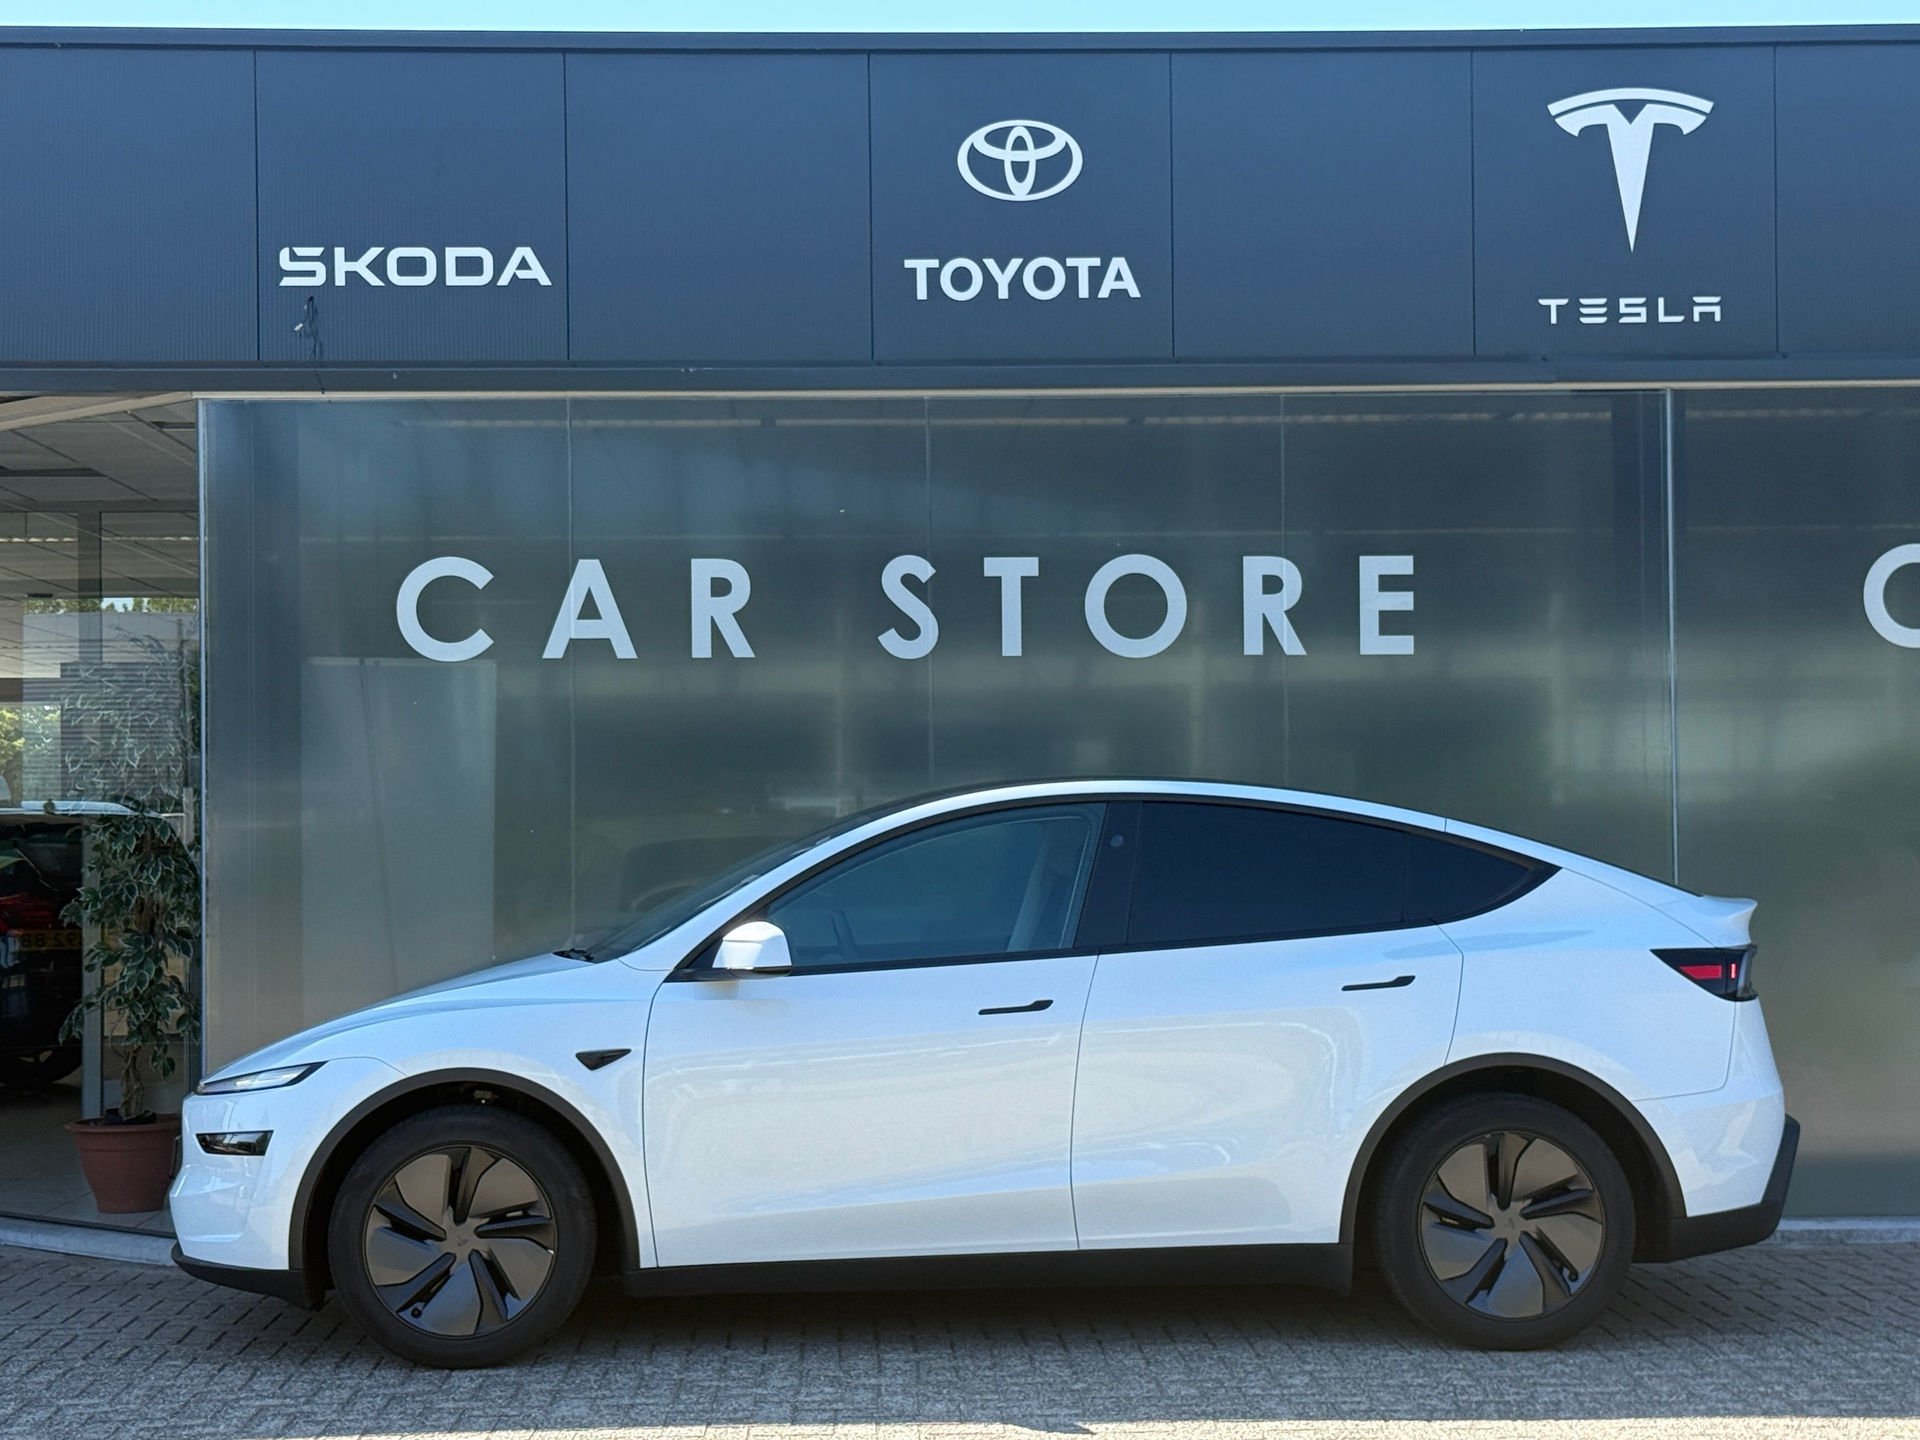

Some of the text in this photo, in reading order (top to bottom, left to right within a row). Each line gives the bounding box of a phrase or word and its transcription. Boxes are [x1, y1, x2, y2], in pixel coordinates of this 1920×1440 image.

[904, 256, 1141, 302] TOYOTA
[1538, 296, 1722, 325] TESLA
[396, 553, 1415, 662] CAR STORE
